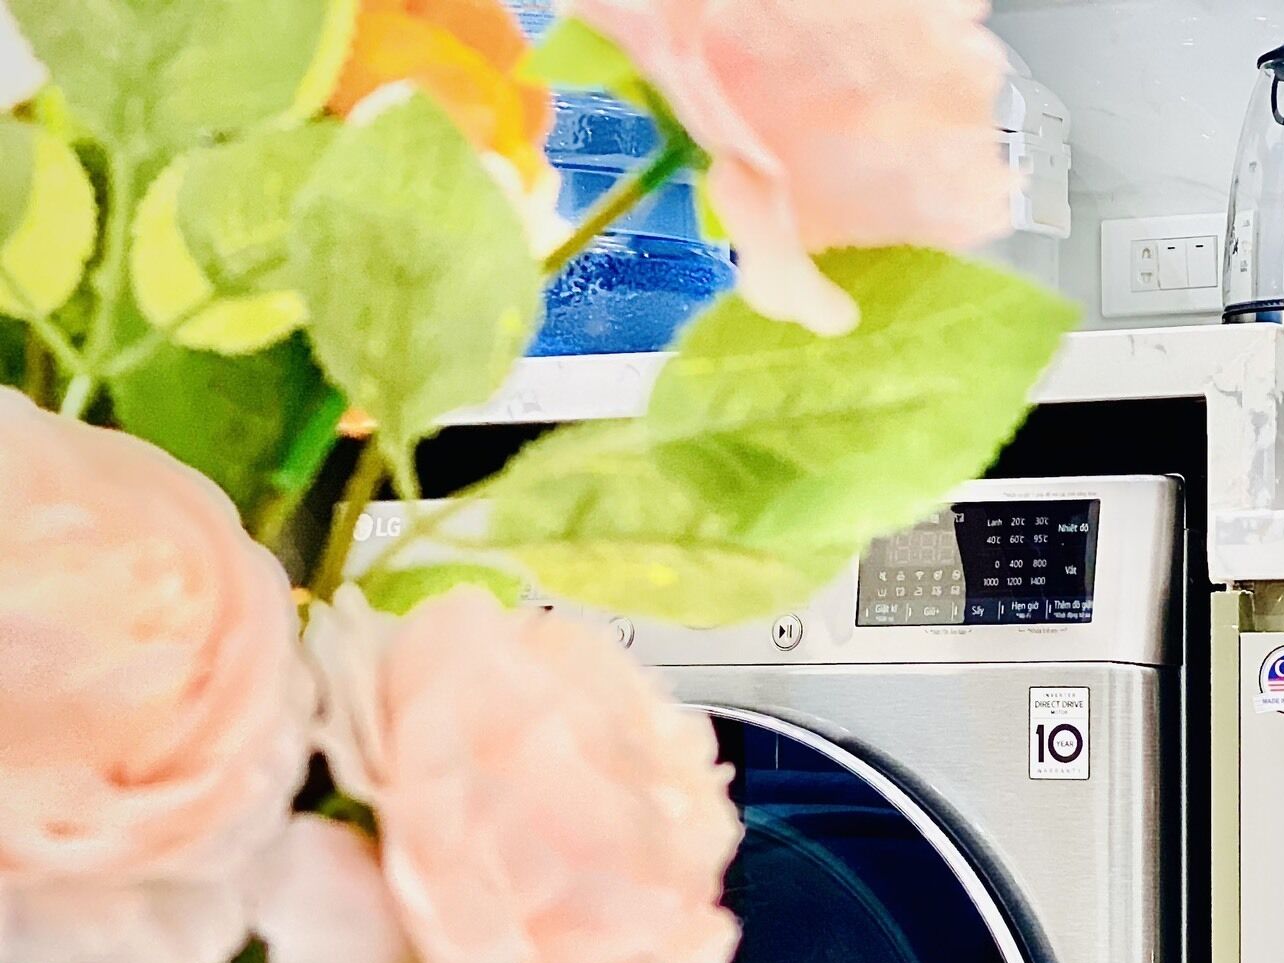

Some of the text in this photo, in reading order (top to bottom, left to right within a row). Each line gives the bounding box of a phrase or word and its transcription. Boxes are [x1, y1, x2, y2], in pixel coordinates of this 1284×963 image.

[375, 517, 401, 537] LG
[995, 560, 1000, 569] 0
[1009, 559, 1023, 569] 400
[1033, 558, 1047, 568] 800
[984, 578, 999, 586] 1000
[1007, 577, 1022, 586] 1200
[1031, 576, 1046, 585] 1400
[1034, 700, 1083, 708] DIRECT DRIVE
[1035, 723, 1083, 763] 10
